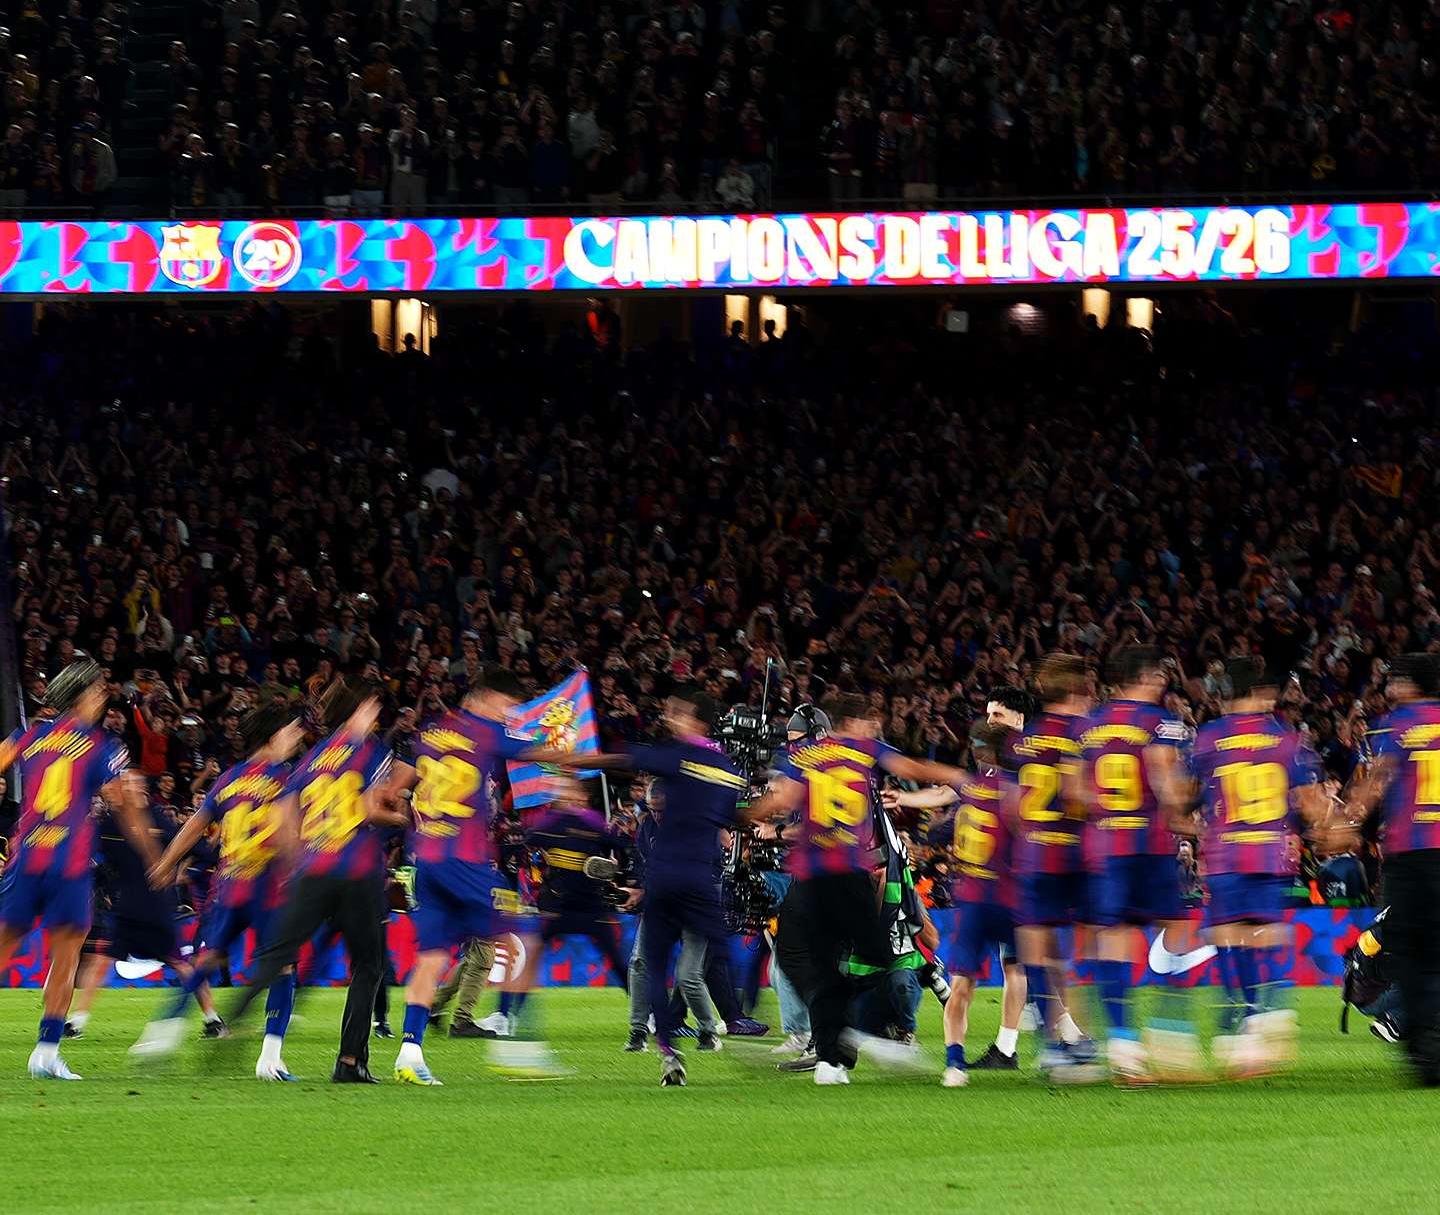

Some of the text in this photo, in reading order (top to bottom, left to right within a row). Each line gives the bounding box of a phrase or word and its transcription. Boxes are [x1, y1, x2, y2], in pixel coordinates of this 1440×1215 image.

[564, 209, 1291, 284] CAMPIONS DE LLIGA 25/26
[1095, 754, 1144, 811] 9
